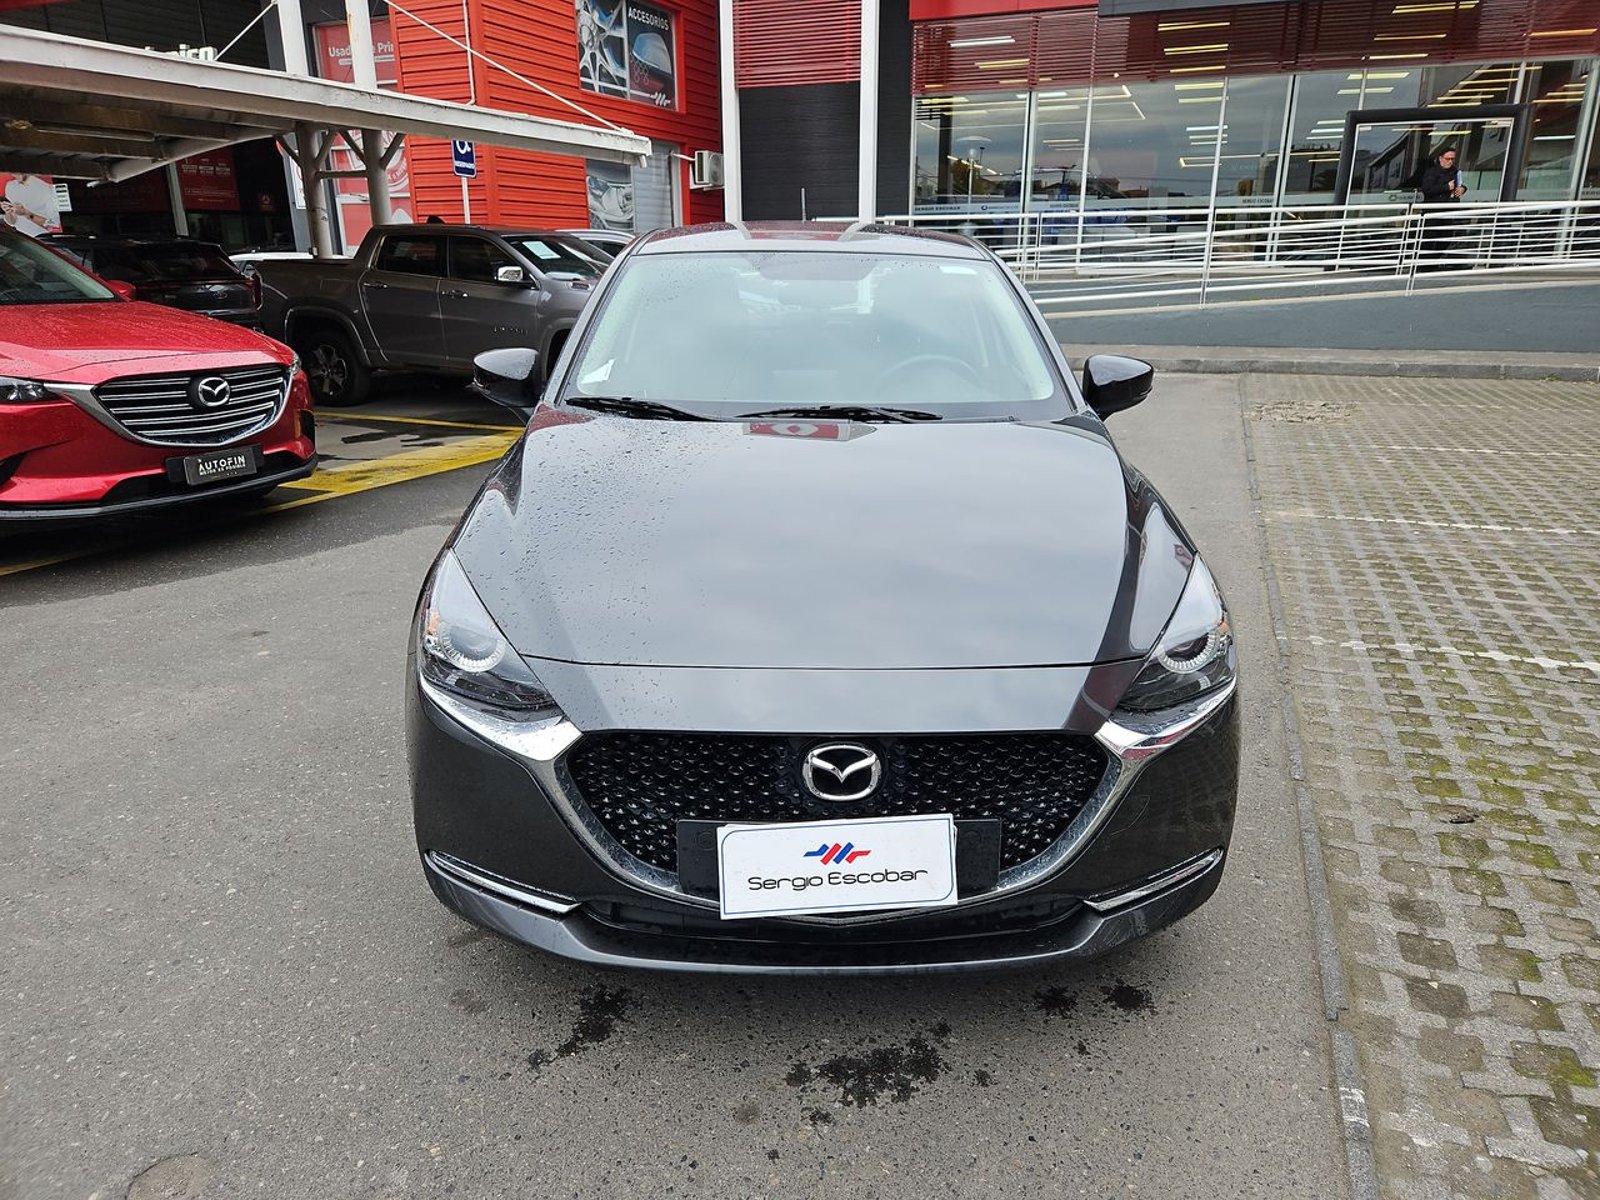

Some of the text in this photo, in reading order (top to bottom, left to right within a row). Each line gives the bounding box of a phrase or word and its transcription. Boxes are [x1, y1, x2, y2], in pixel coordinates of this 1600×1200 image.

[628, 6, 669, 31] ACCESORIOS
[328, 45, 352, 57] Usad
[198, 456, 246, 471] AUTOFIN
[747, 868, 928, 891] Sergio Escobar
